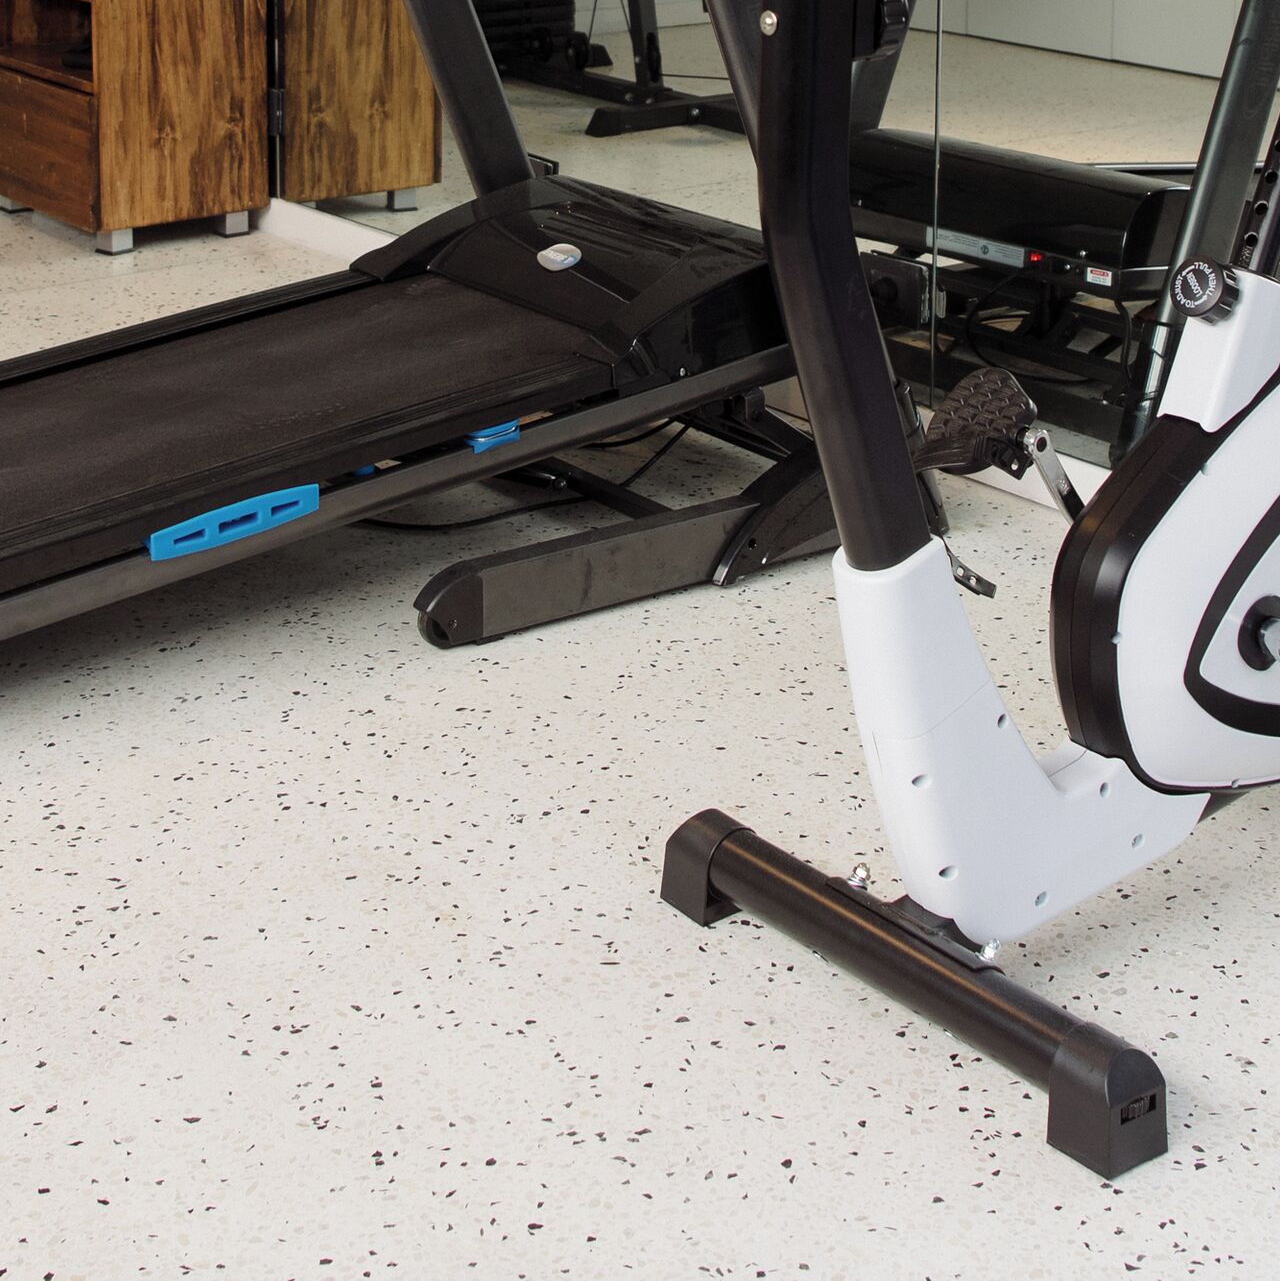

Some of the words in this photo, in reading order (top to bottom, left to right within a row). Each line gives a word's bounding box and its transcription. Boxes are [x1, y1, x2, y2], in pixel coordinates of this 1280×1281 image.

[1193, 261, 1213, 275] PULL
[1174, 274, 1187, 305] ADJUST
[1185, 272, 1203, 297] LOOSEN
[1205, 273, 1217, 296] THEN
[1184, 300, 1196, 308] TO
